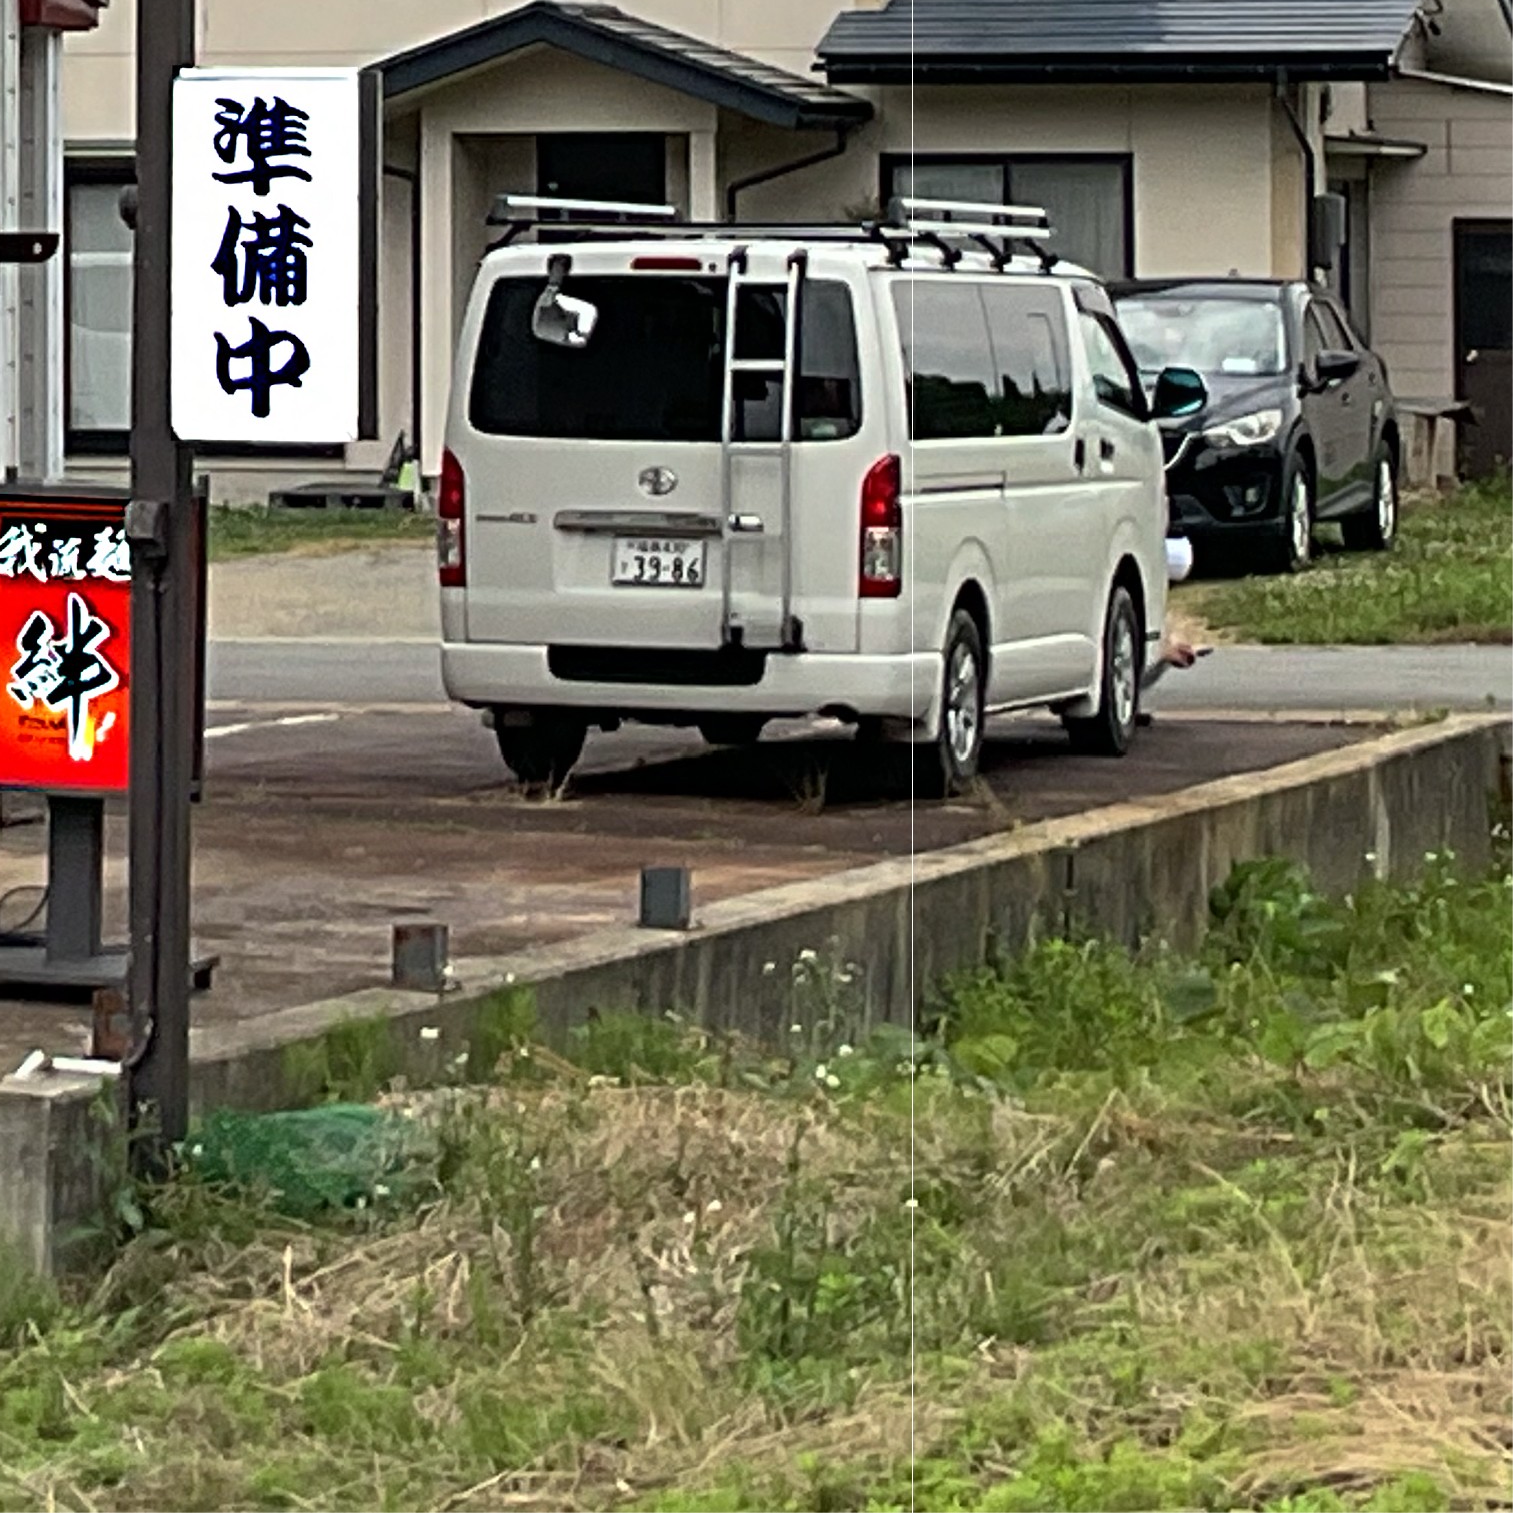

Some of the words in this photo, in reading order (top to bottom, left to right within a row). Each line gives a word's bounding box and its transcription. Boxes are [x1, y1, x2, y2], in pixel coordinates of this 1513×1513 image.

[211, 95, 313, 420] 準備中
[6, 592, 121, 761] 絆
